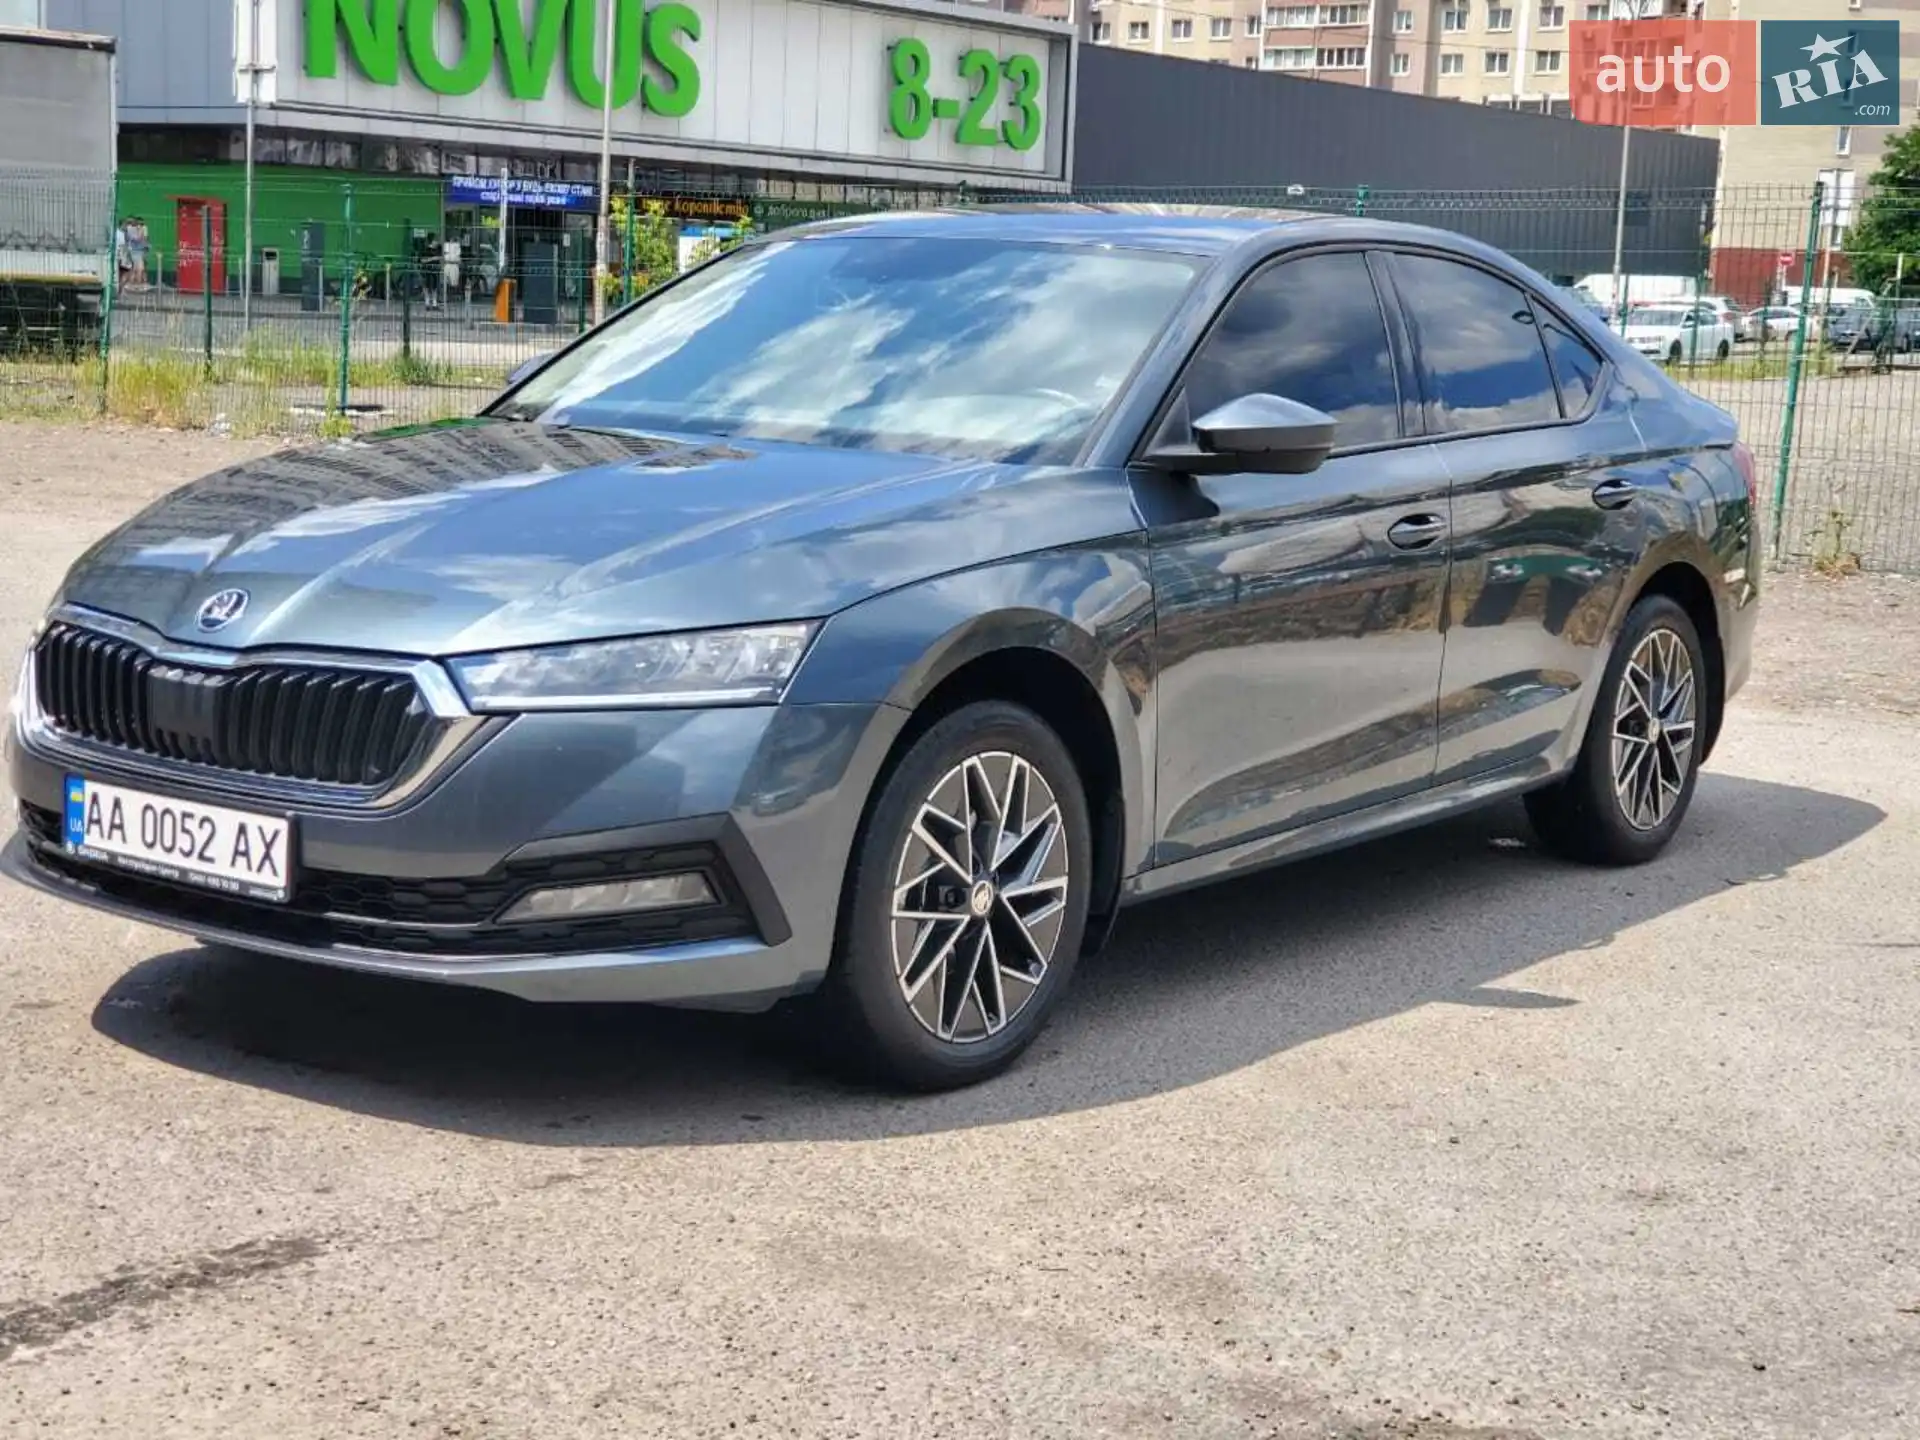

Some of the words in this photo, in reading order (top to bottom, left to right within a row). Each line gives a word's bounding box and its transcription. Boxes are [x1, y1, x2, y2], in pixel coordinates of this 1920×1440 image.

[304, 0, 701, 117] NOVUS
[889, 37, 1041, 152] 8-23
[86, 791, 127, 844] AA
[141, 803, 216, 863] 0052
[230, 821, 280, 878] AX
